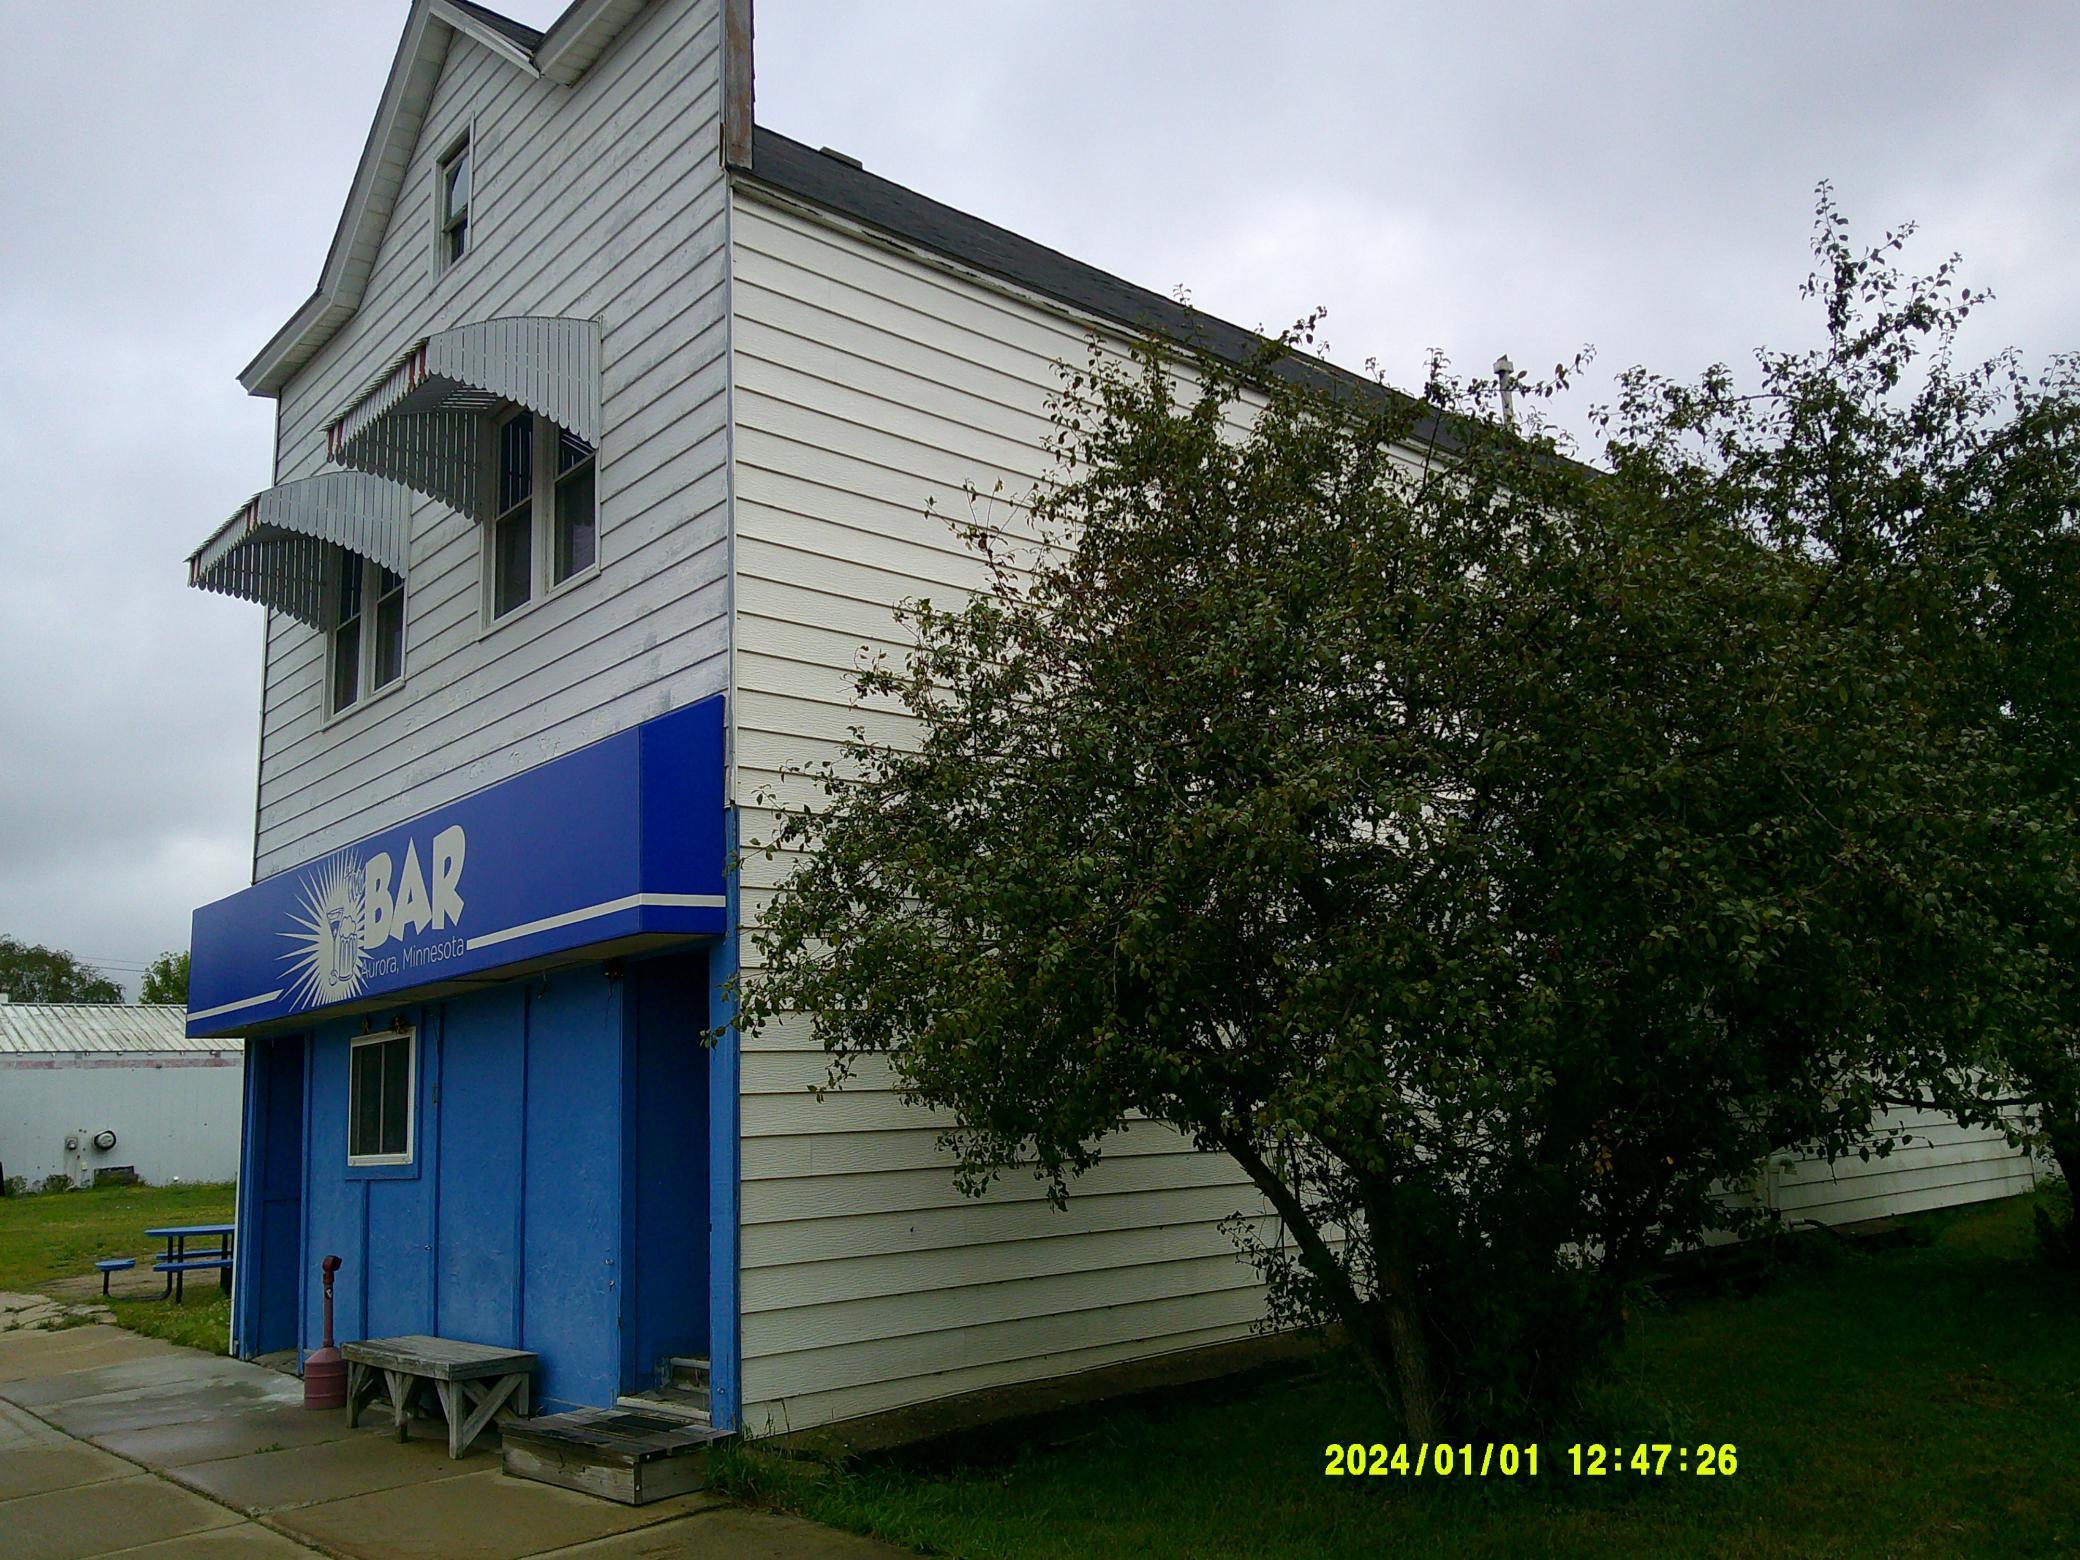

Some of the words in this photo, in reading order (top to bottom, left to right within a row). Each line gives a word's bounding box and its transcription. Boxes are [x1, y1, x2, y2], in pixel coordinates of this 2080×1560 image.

[364, 825, 466, 950] BAR
[361, 954, 400, 980] Aurora,
[402, 937, 465, 970] Minnesota
